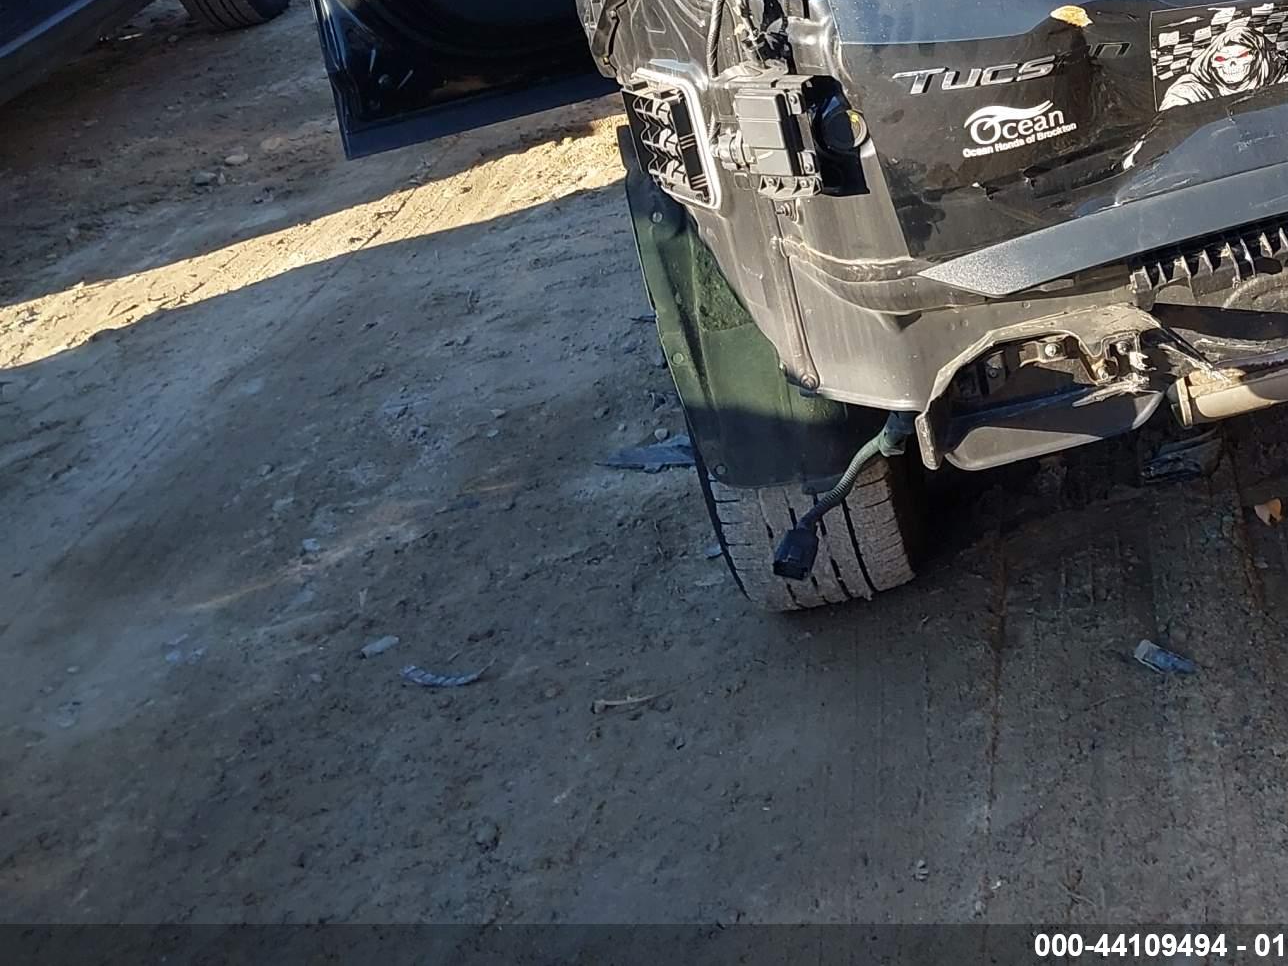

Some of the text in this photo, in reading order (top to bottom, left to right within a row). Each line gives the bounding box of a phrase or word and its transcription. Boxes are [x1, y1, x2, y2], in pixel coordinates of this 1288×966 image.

[892, 42, 1130, 95] TUCSN
[963, 122, 1077, 158] Ocean Honda of Brockton
[969, 106, 1065, 145] Ocean
